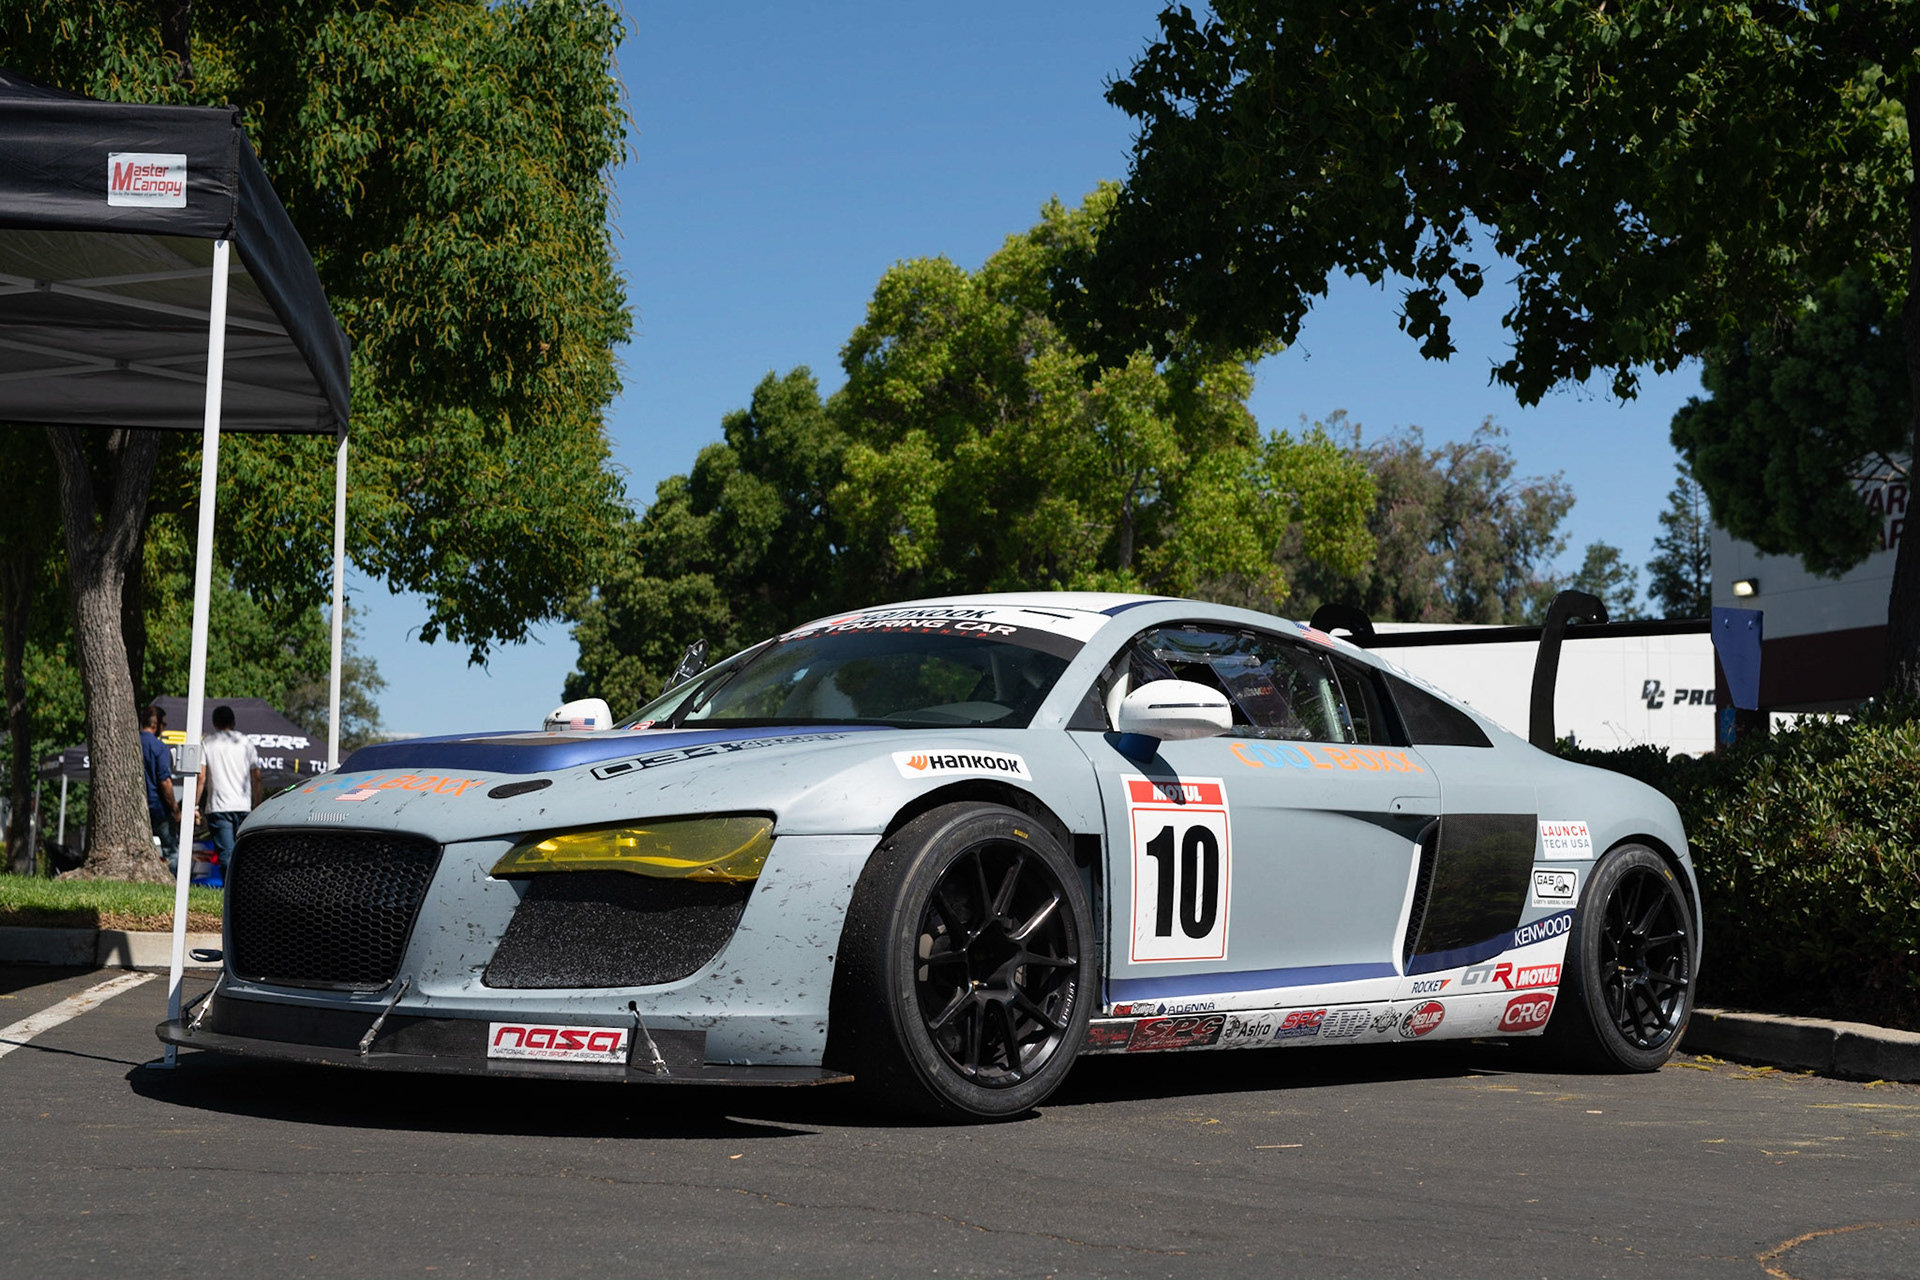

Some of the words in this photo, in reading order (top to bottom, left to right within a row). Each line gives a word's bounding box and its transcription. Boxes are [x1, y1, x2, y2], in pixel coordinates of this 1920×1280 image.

[111, 162, 169, 190] Master
[132, 178, 182, 196] Canopy
[825, 619, 949, 635] TOURING
[954, 621, 1018, 636] CAR
[1153, 784, 1203, 803] MOTUL
[1541, 825, 1587, 836] LAUNCH
[1544, 839, 1568, 849] TECH
[1571, 839, 1590, 848] USA
[1146, 825, 1219, 939] 10
[1537, 875, 1555, 885] GAS
[1514, 914, 1572, 946] KENWOOD
[1461, 963, 1514, 989] GTR
[1517, 969, 1558, 987] MOTUL
[1411, 979, 1444, 994] ROCKET
[1167, 1002, 1215, 1014] ADENNA
[1505, 1001, 1549, 1024] CRC
[1413, 1013, 1428, 1025] RED
[1237, 1021, 1271, 1038] Astro
[493, 1048, 526, 1056] NATIONAL
